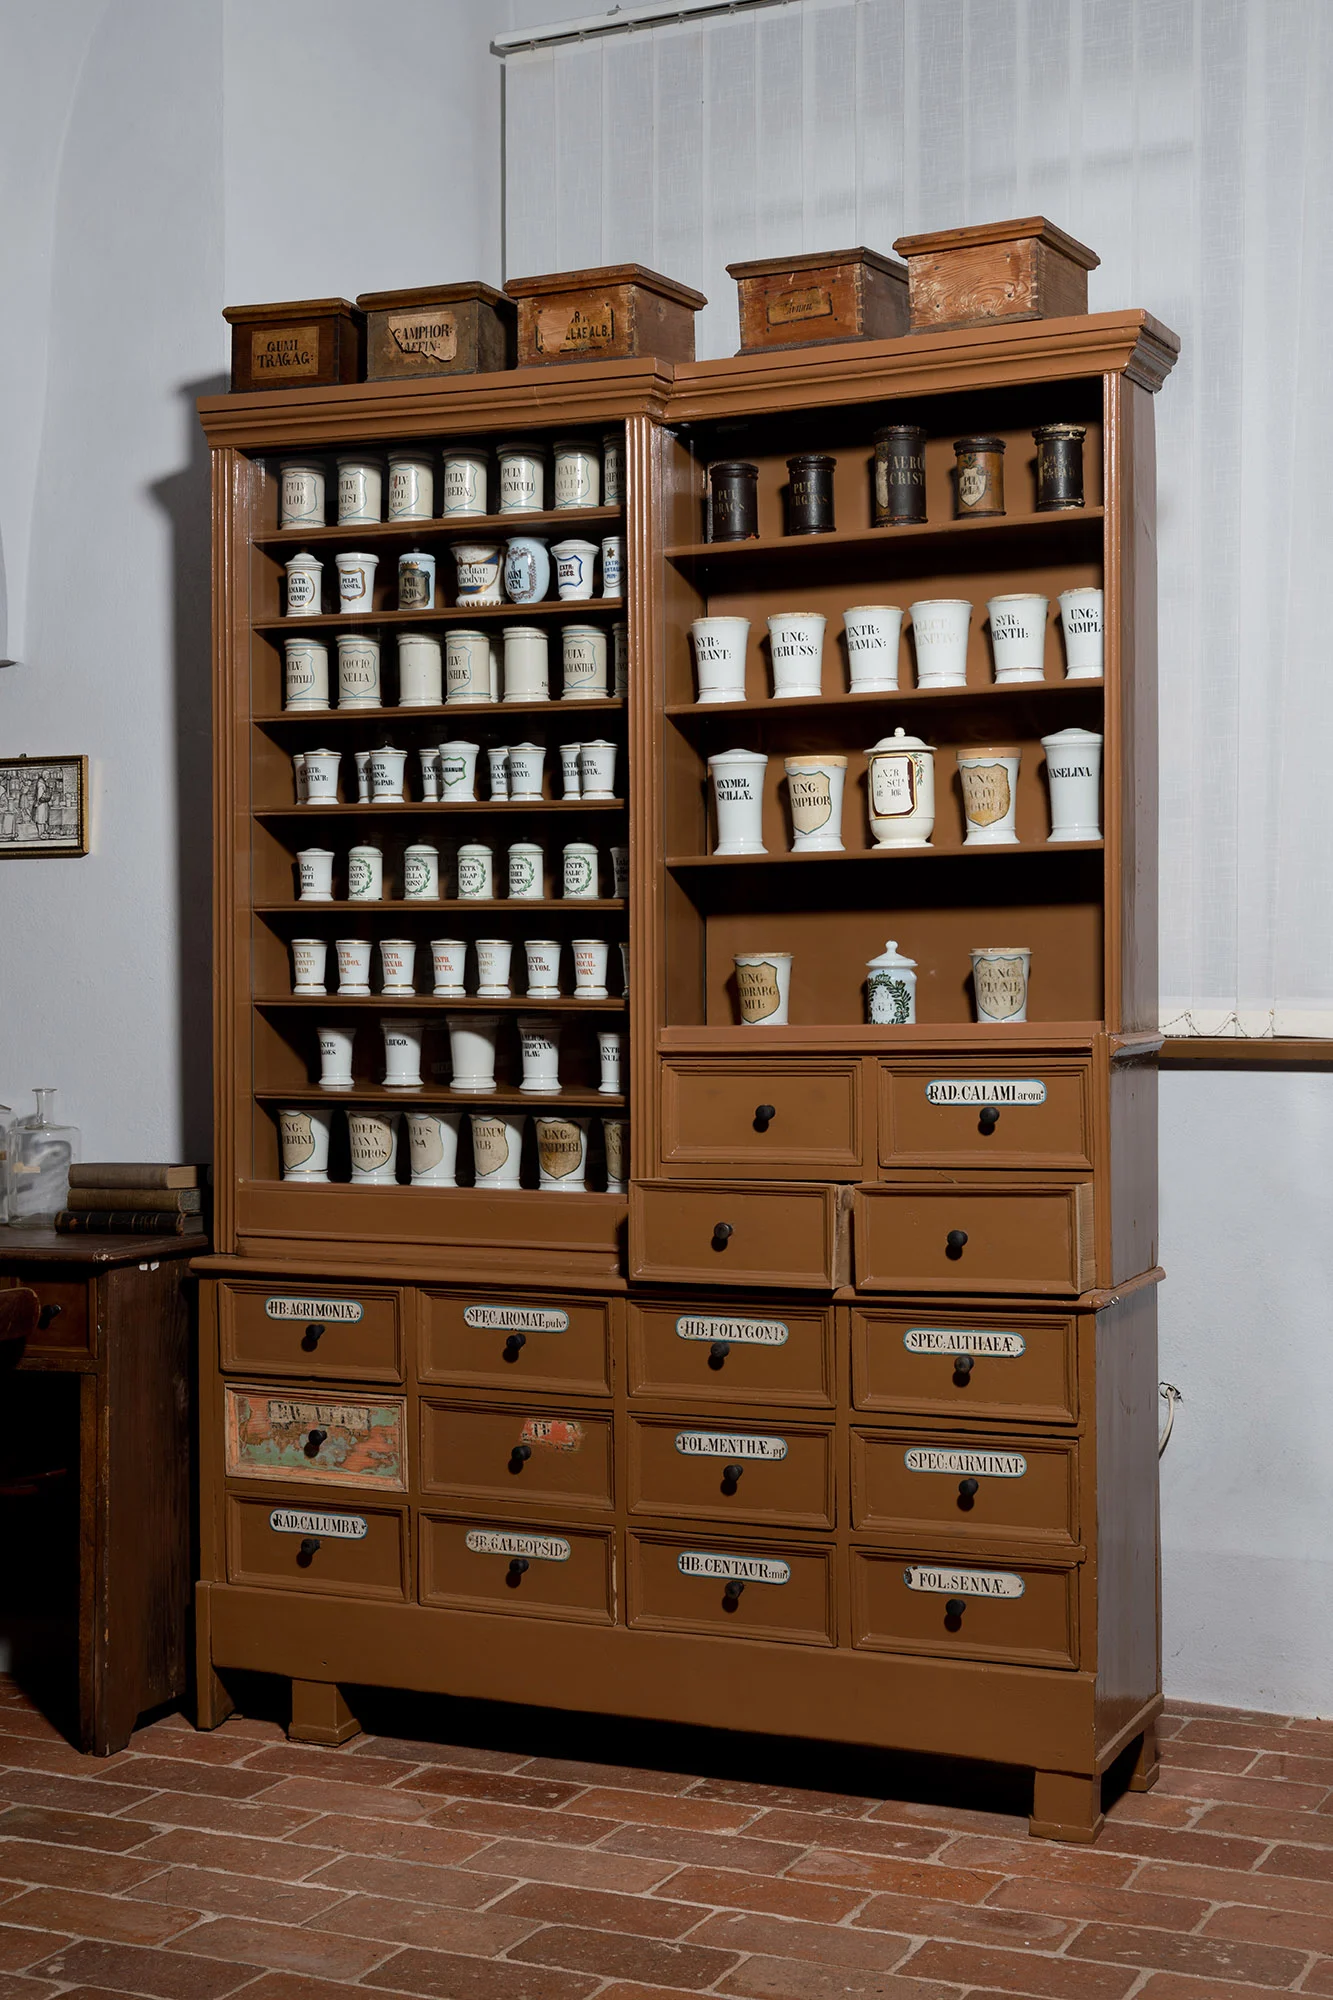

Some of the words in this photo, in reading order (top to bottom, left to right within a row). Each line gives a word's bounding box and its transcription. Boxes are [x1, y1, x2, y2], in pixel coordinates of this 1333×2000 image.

[1070, 608, 1099, 620] UNG:
[996, 614, 1020, 627] SYR:
[781, 631, 809, 643] UNG:
